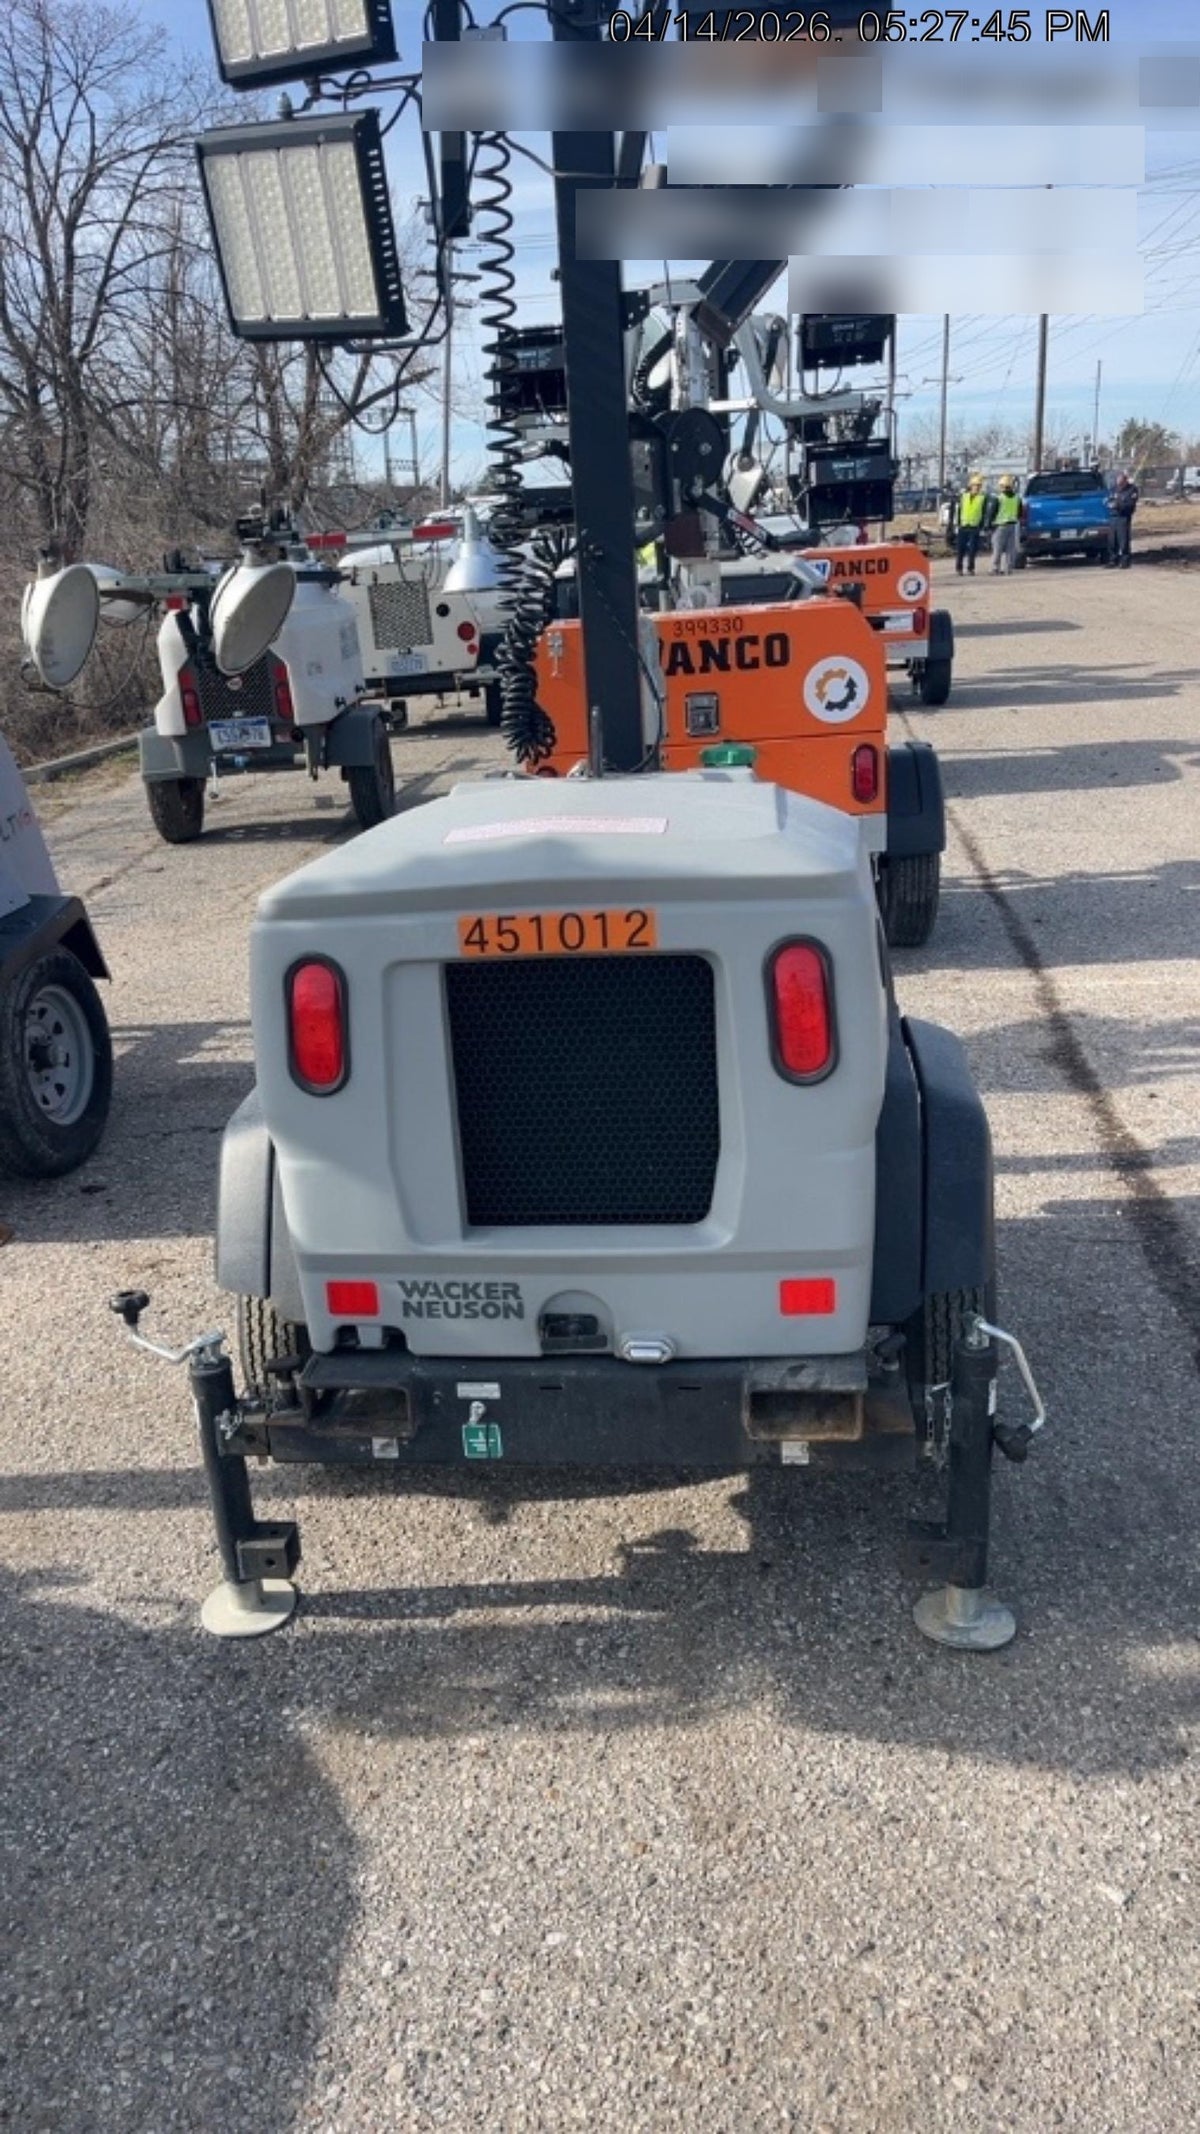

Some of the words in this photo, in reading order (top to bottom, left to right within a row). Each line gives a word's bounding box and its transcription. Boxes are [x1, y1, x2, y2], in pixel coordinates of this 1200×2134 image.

[828, 557, 889, 580] ANCO
[672, 616, 744, 637] 399330
[659, 632, 790, 677] ANCO
[464, 909, 650, 953] 451012
[398, 1279, 523, 1300] WACKER
[402, 1301, 525, 1319] NEUSON
